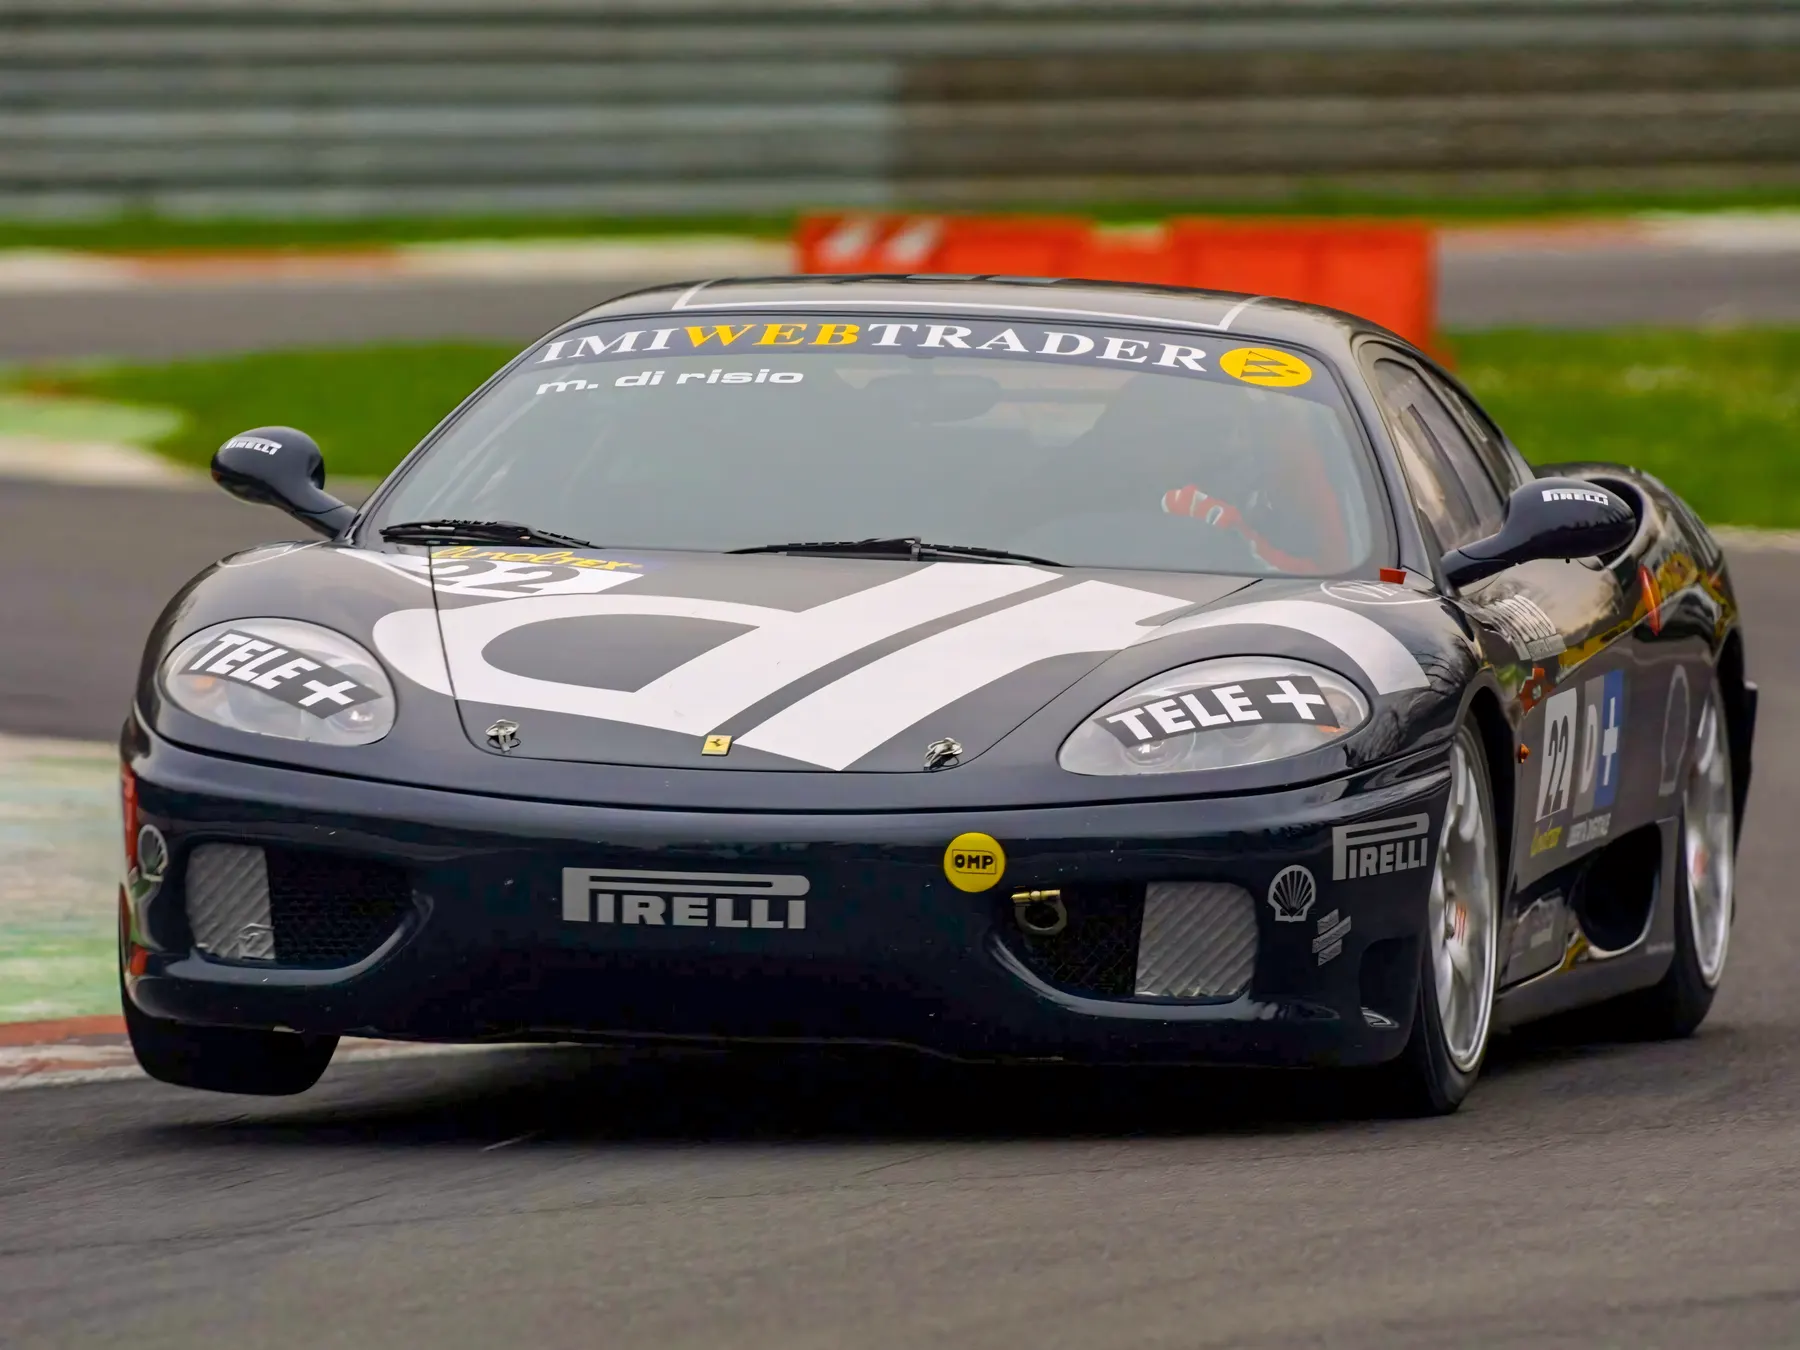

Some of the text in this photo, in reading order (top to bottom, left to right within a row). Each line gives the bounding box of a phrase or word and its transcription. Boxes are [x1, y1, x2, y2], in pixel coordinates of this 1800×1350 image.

[536, 369, 804, 394] m. di risio
[1542, 489, 1609, 505] PIRELLI
[189, 633, 322, 690] TELE
[1106, 684, 1262, 740] TELE
[1542, 715, 1569, 818] 22
[955, 854, 994, 869] OMP
[1332, 812, 1430, 881] PIRELLI
[562, 867, 810, 930] PIRELLI
